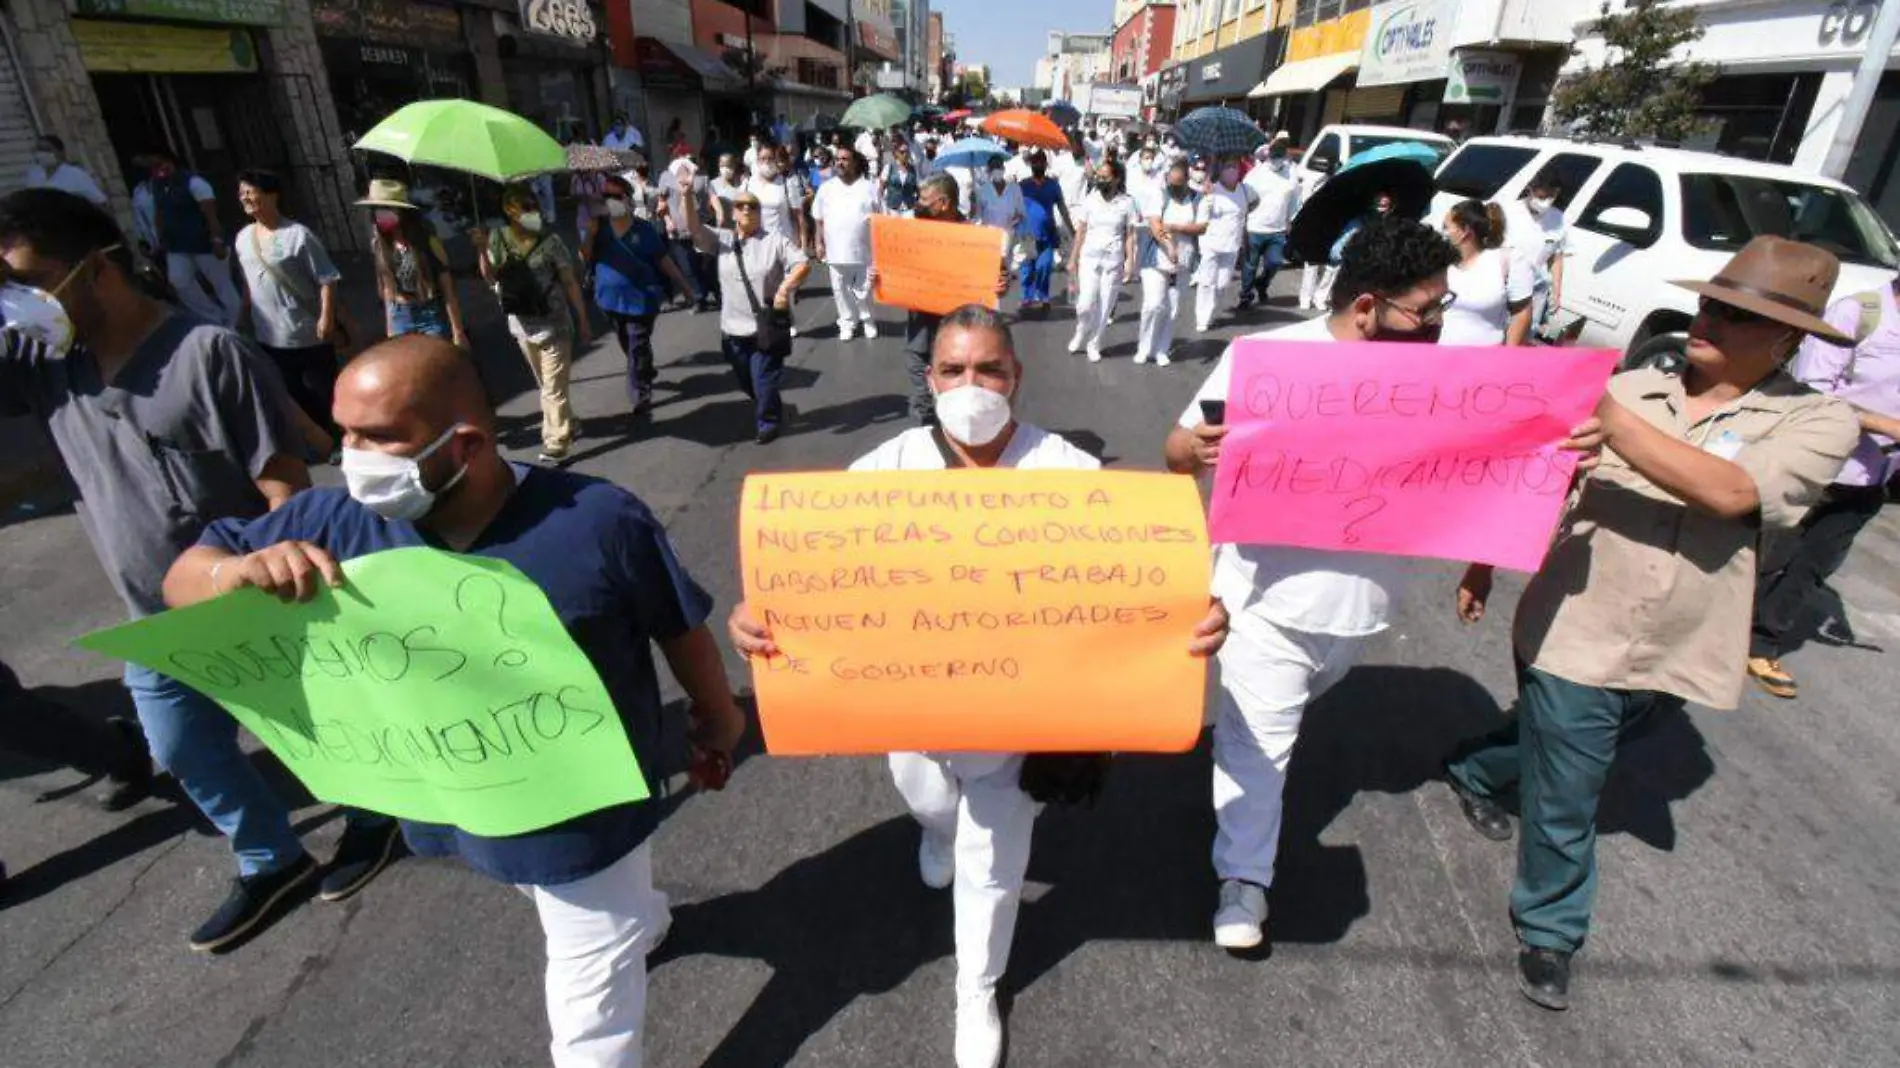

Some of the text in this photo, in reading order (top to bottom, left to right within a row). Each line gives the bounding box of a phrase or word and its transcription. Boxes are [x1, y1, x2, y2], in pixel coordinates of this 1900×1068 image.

[1244, 373, 1550, 424] QUEREMOS
[1231, 450, 1572, 498] MEDICAMENTOS
[1086, 487, 1112, 509] A
[1341, 496, 1388, 545] ?
[756, 523, 1197, 551] NUESTRAS CONDICIONES
[755, 564, 1167, 593] LABORALES DE TRABAJO
[456, 573, 528, 669] ?
[912, 605, 1169, 631] AUTORIDADES
[766, 653, 1021, 682] DE GOBIERNO
